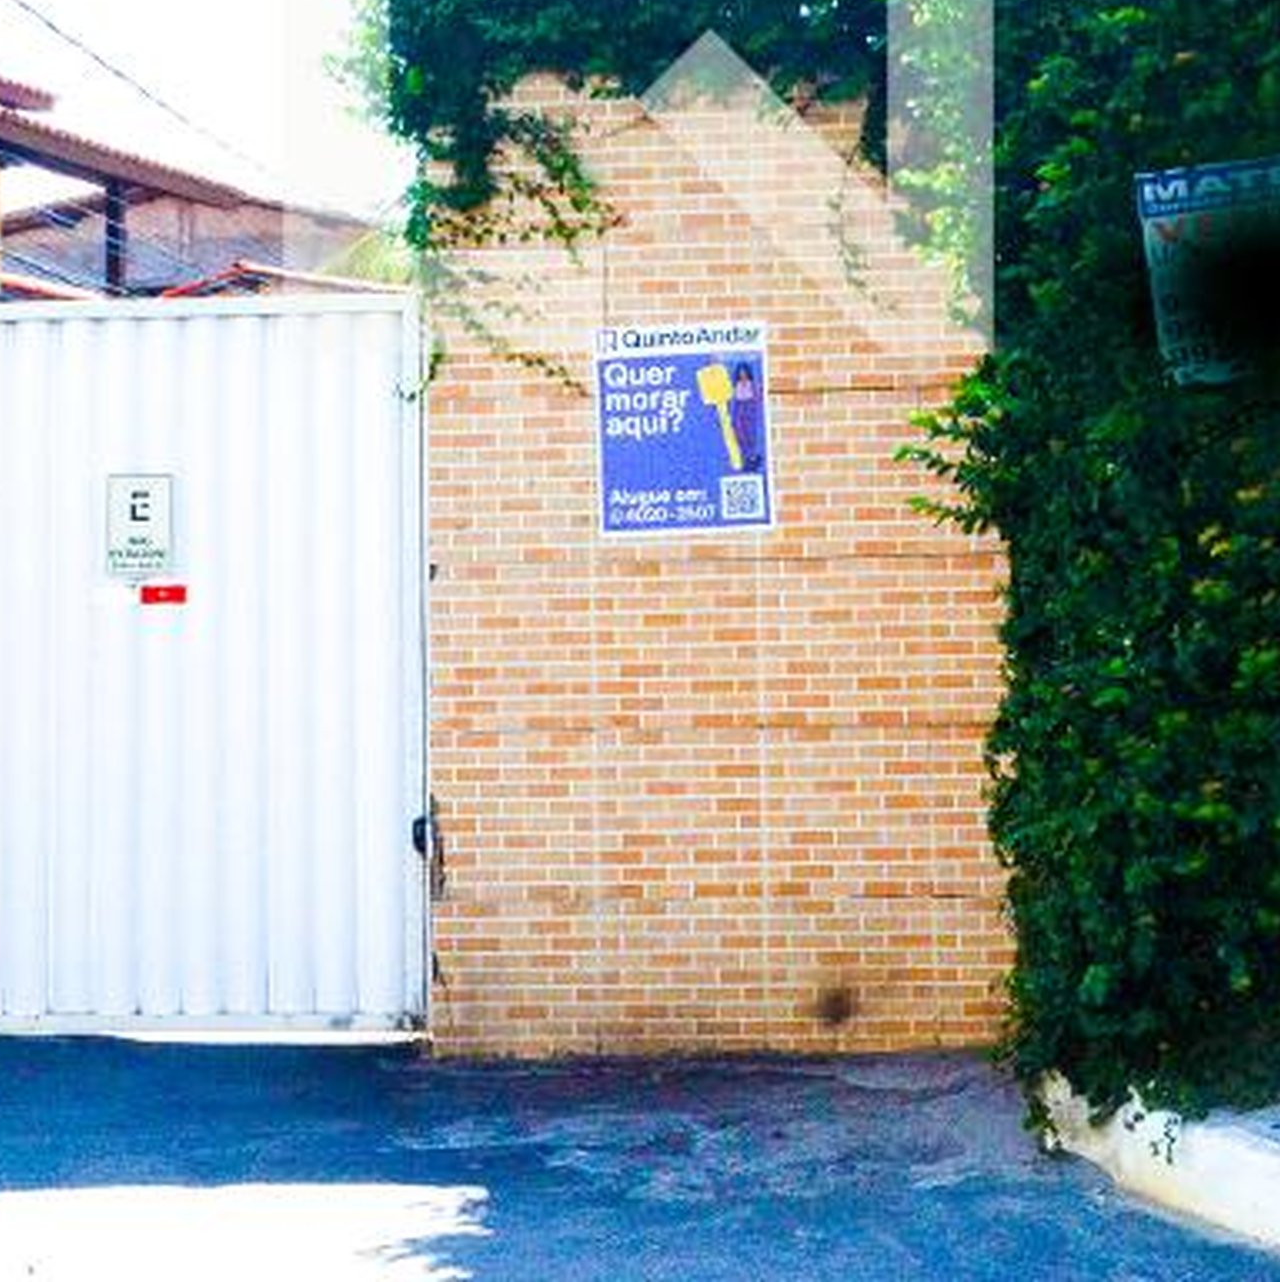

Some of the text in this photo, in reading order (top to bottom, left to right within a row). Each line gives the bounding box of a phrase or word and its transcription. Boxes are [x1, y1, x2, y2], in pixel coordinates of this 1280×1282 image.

[622, 327, 760, 349] QuintoAndar
[604, 363, 676, 388] Quer
[605, 389, 691, 412] morar
[606, 407, 684, 441] aqui?
